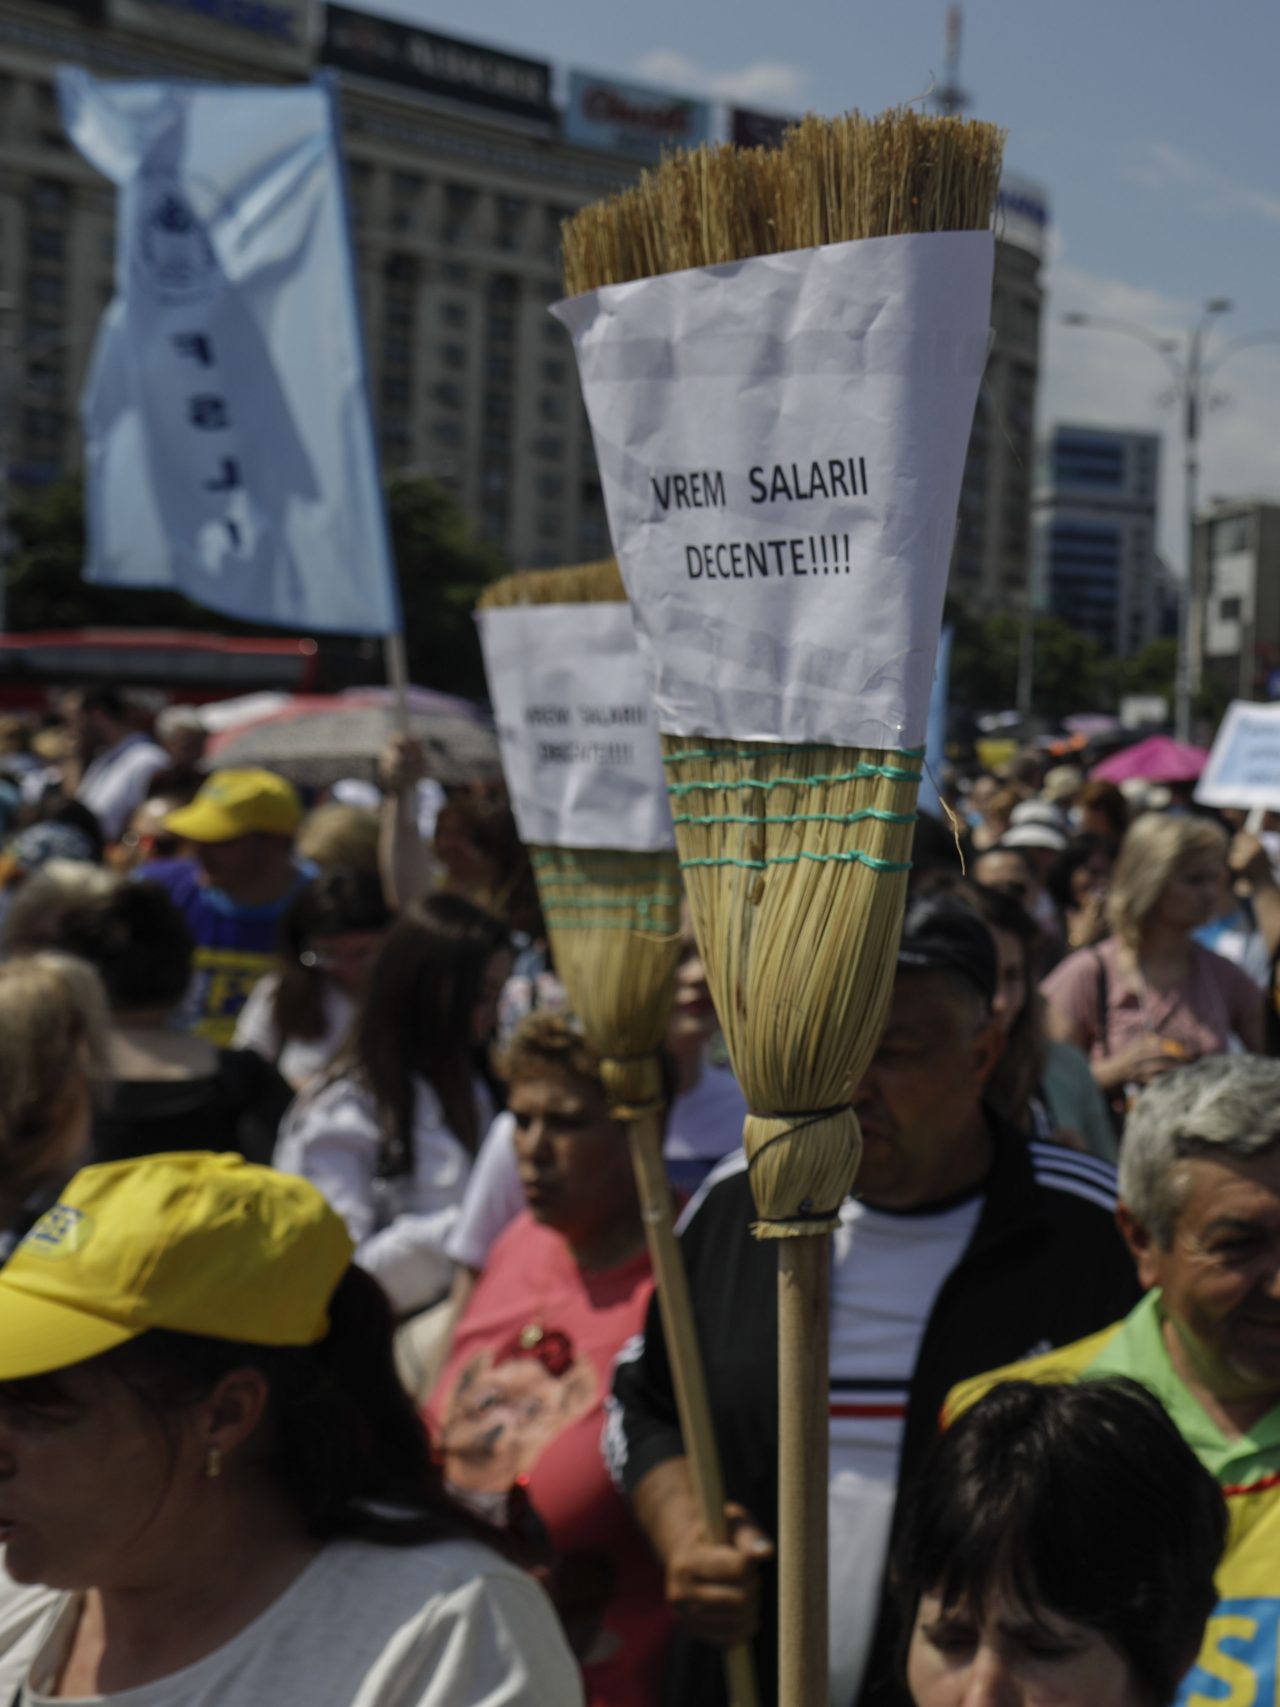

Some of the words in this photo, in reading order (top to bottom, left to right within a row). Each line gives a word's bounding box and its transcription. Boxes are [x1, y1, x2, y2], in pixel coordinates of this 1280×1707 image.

[650, 471, 726, 511] VREM
[748, 456, 868, 505] SALARII
[685, 533, 850, 580] DECENTE!!!!
